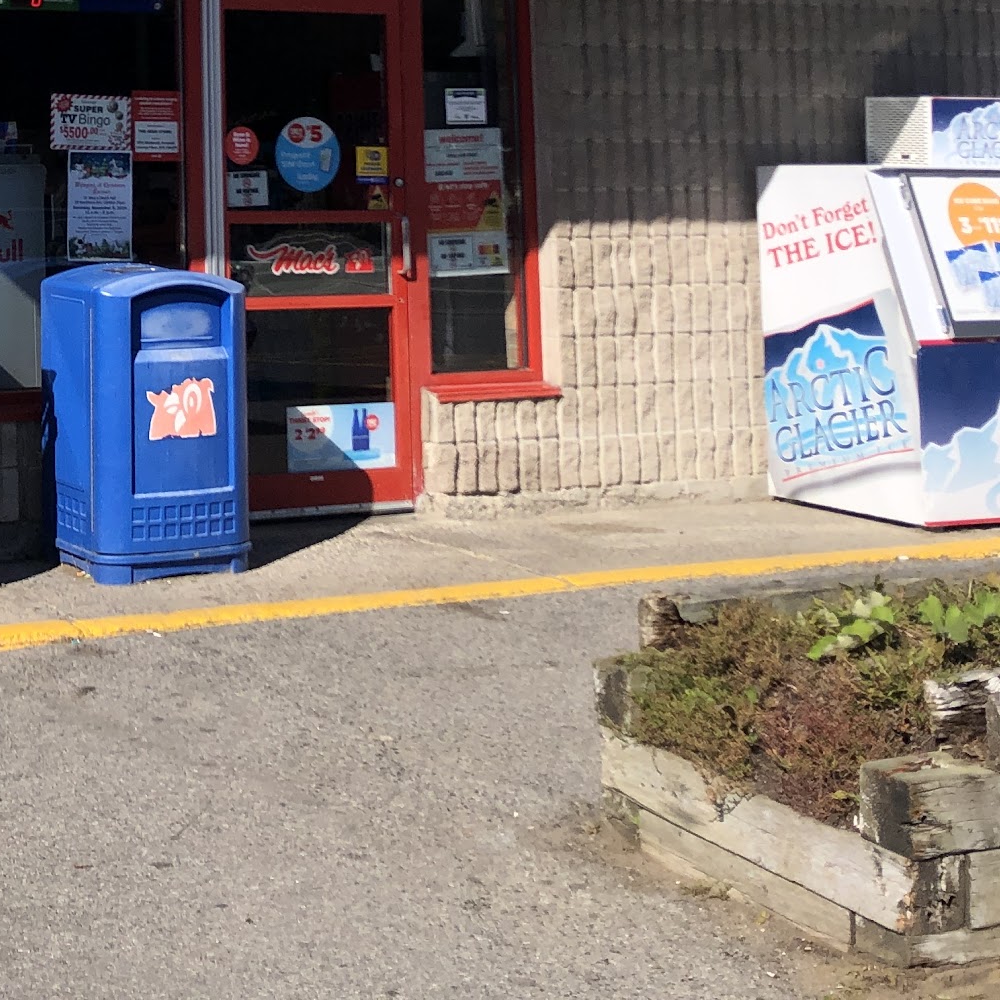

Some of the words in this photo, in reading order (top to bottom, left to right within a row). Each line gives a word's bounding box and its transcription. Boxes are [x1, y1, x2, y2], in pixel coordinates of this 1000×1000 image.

[60, 114, 78, 125] TV
[78, 114, 112, 128] Bingo
[73, 105, 104, 114] SUPER
[762, 215, 808, 241] Don't
[811, 197, 870, 228] Forget
[766, 237, 821, 268] THE
[825, 220, 878, 254] ICE!
[769, 346, 896, 423] ARCTIC
[774, 399, 908, 463] GLACIER
